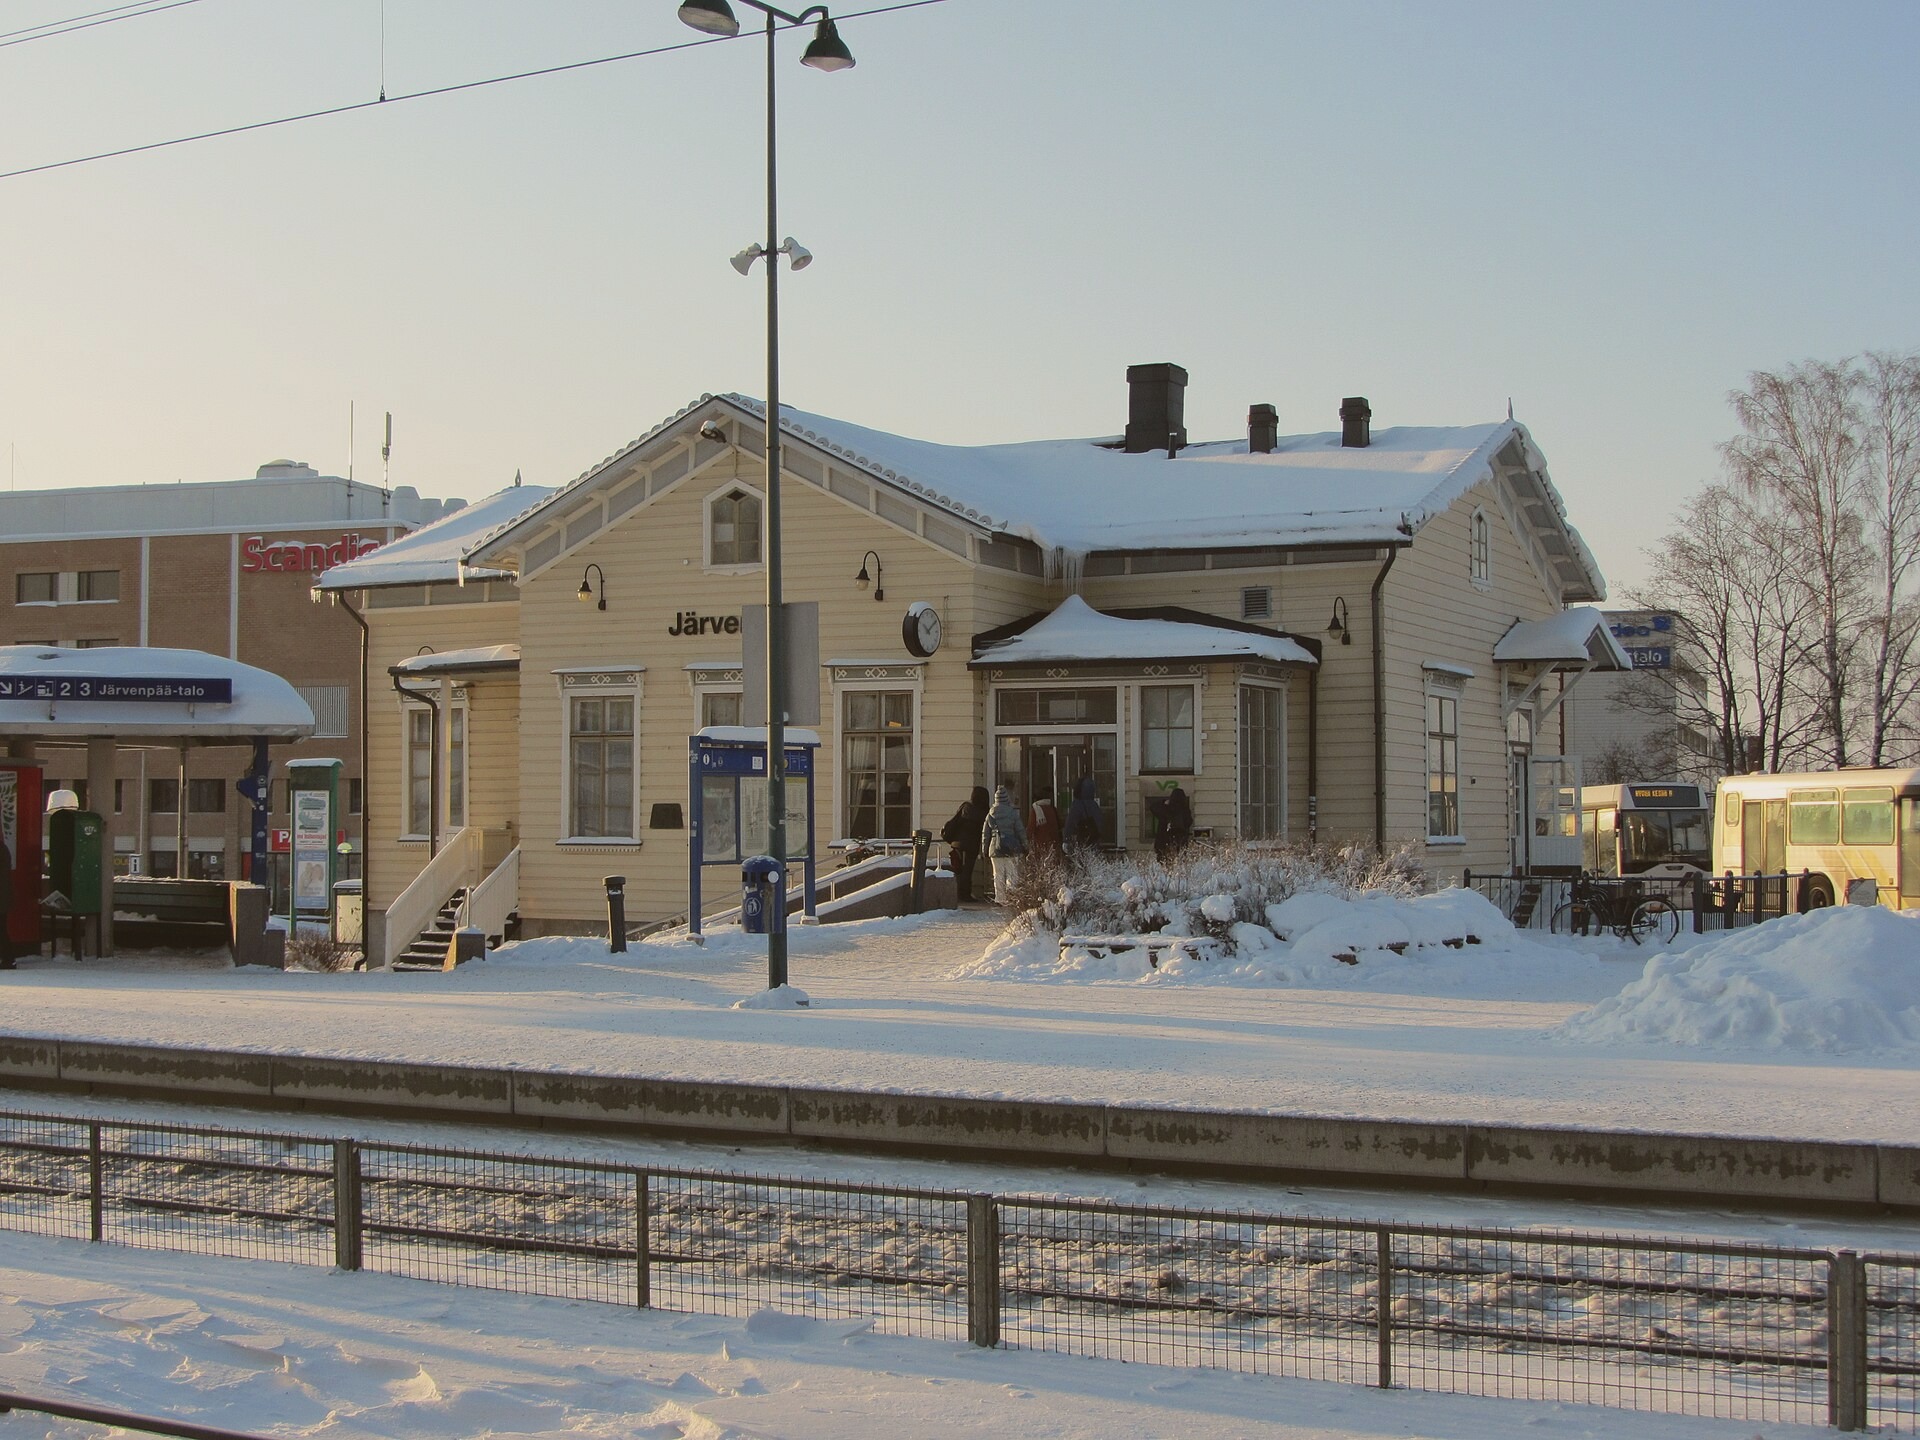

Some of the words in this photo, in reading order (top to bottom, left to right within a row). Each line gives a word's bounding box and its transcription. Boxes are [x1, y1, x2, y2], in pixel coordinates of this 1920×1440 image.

[668, 611, 743, 637] Järve
[60, 682, 71, 696] 2
[80, 682, 91, 696] 3
[99, 684, 205, 698] Järvenpää-talo
